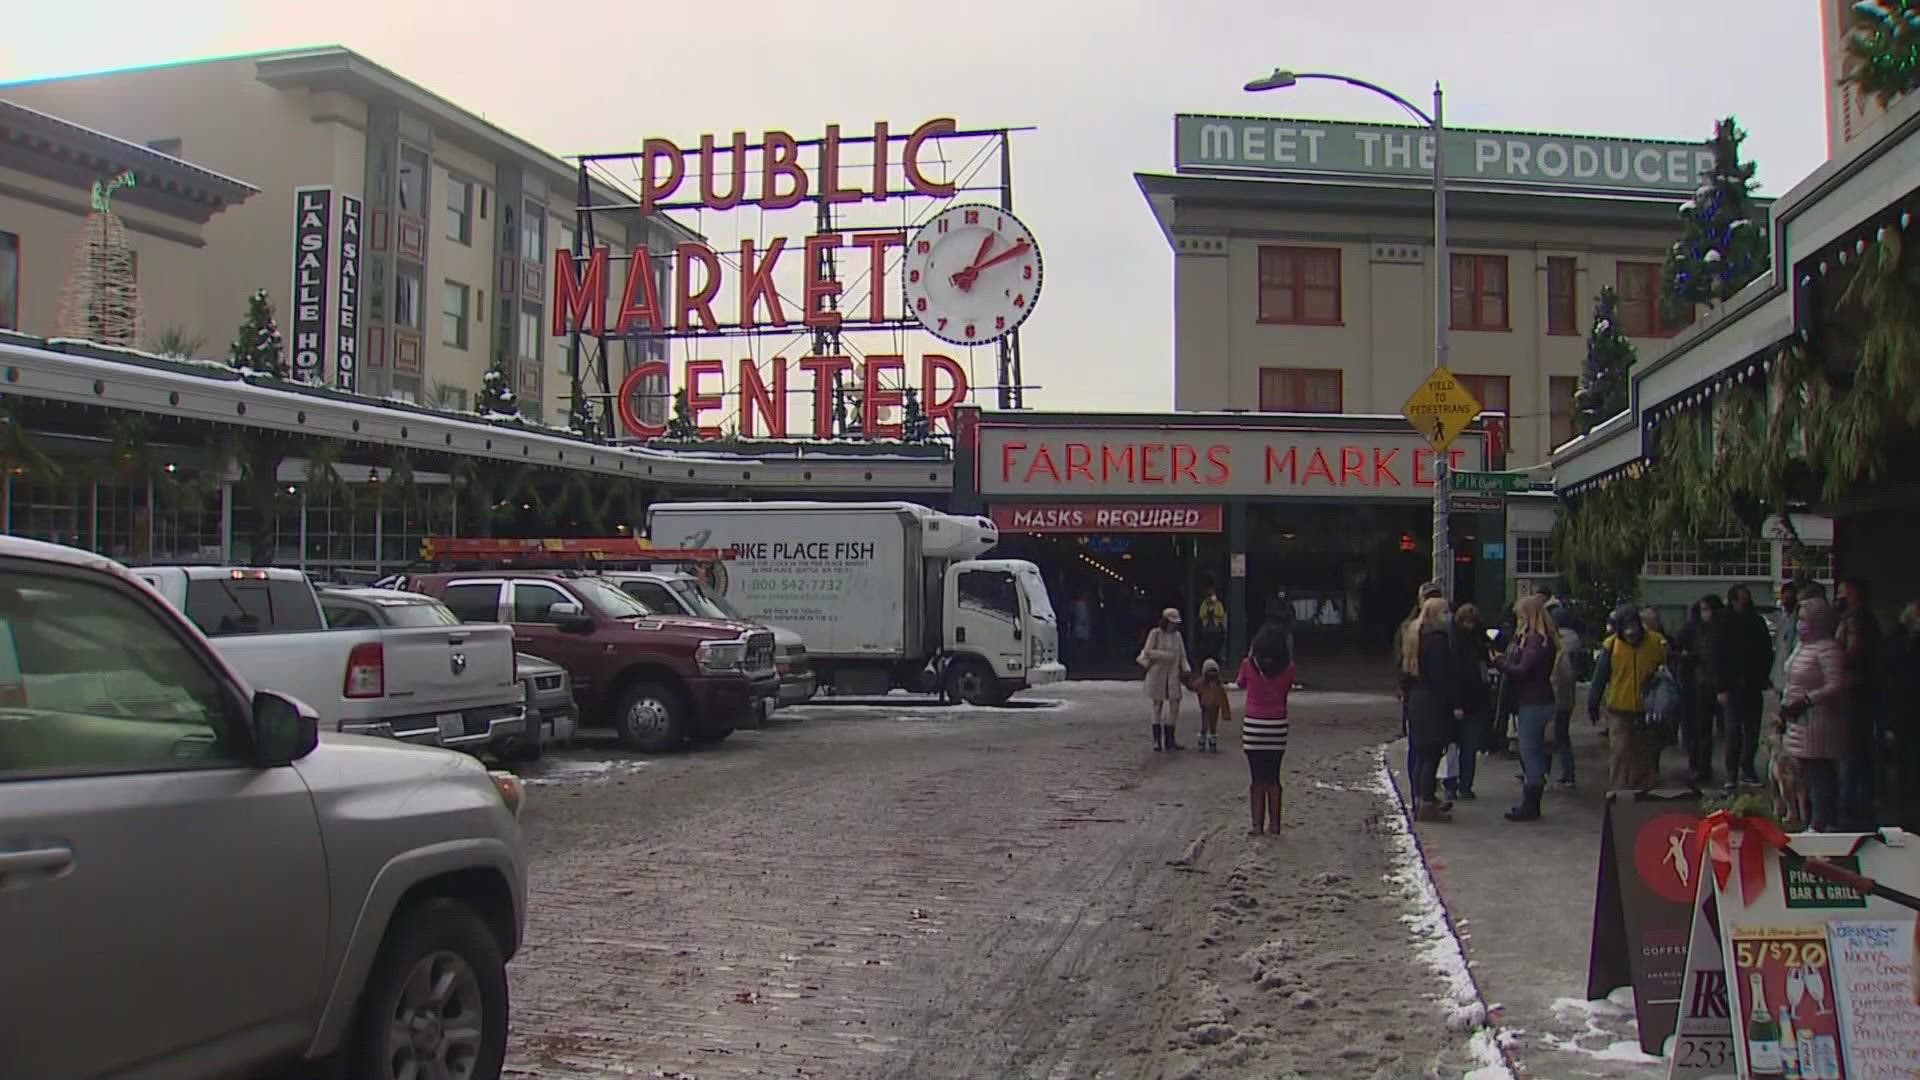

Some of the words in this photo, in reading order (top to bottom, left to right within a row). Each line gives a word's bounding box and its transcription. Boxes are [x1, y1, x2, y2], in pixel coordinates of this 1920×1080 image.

[1200, 123, 1327, 165] MEET
[1354, 131, 1435, 169] THE
[640, 118, 957, 216] PUBLIC
[552, 232, 907, 337] MARKET
[1428, 380, 1455, 392] YIELD
[616, 354, 968, 442] CENTER
[1435, 393, 1447, 403] TO
[1410, 404, 1471, 415] PEDESTRIANS
[1001, 442, 1233, 488] FARMERS
[1265, 444, 1466, 488] MARKET
[1012, 508, 1084, 528] MASKS
[1096, 508, 1201, 529] REQUIRED
[731, 542, 768, 560] PIKE
[773, 542, 829, 560] PLACE
[835, 542, 875, 560] FISH
[1789, 886, 1812, 900] BAR
[1815, 887, 1825, 900] &
